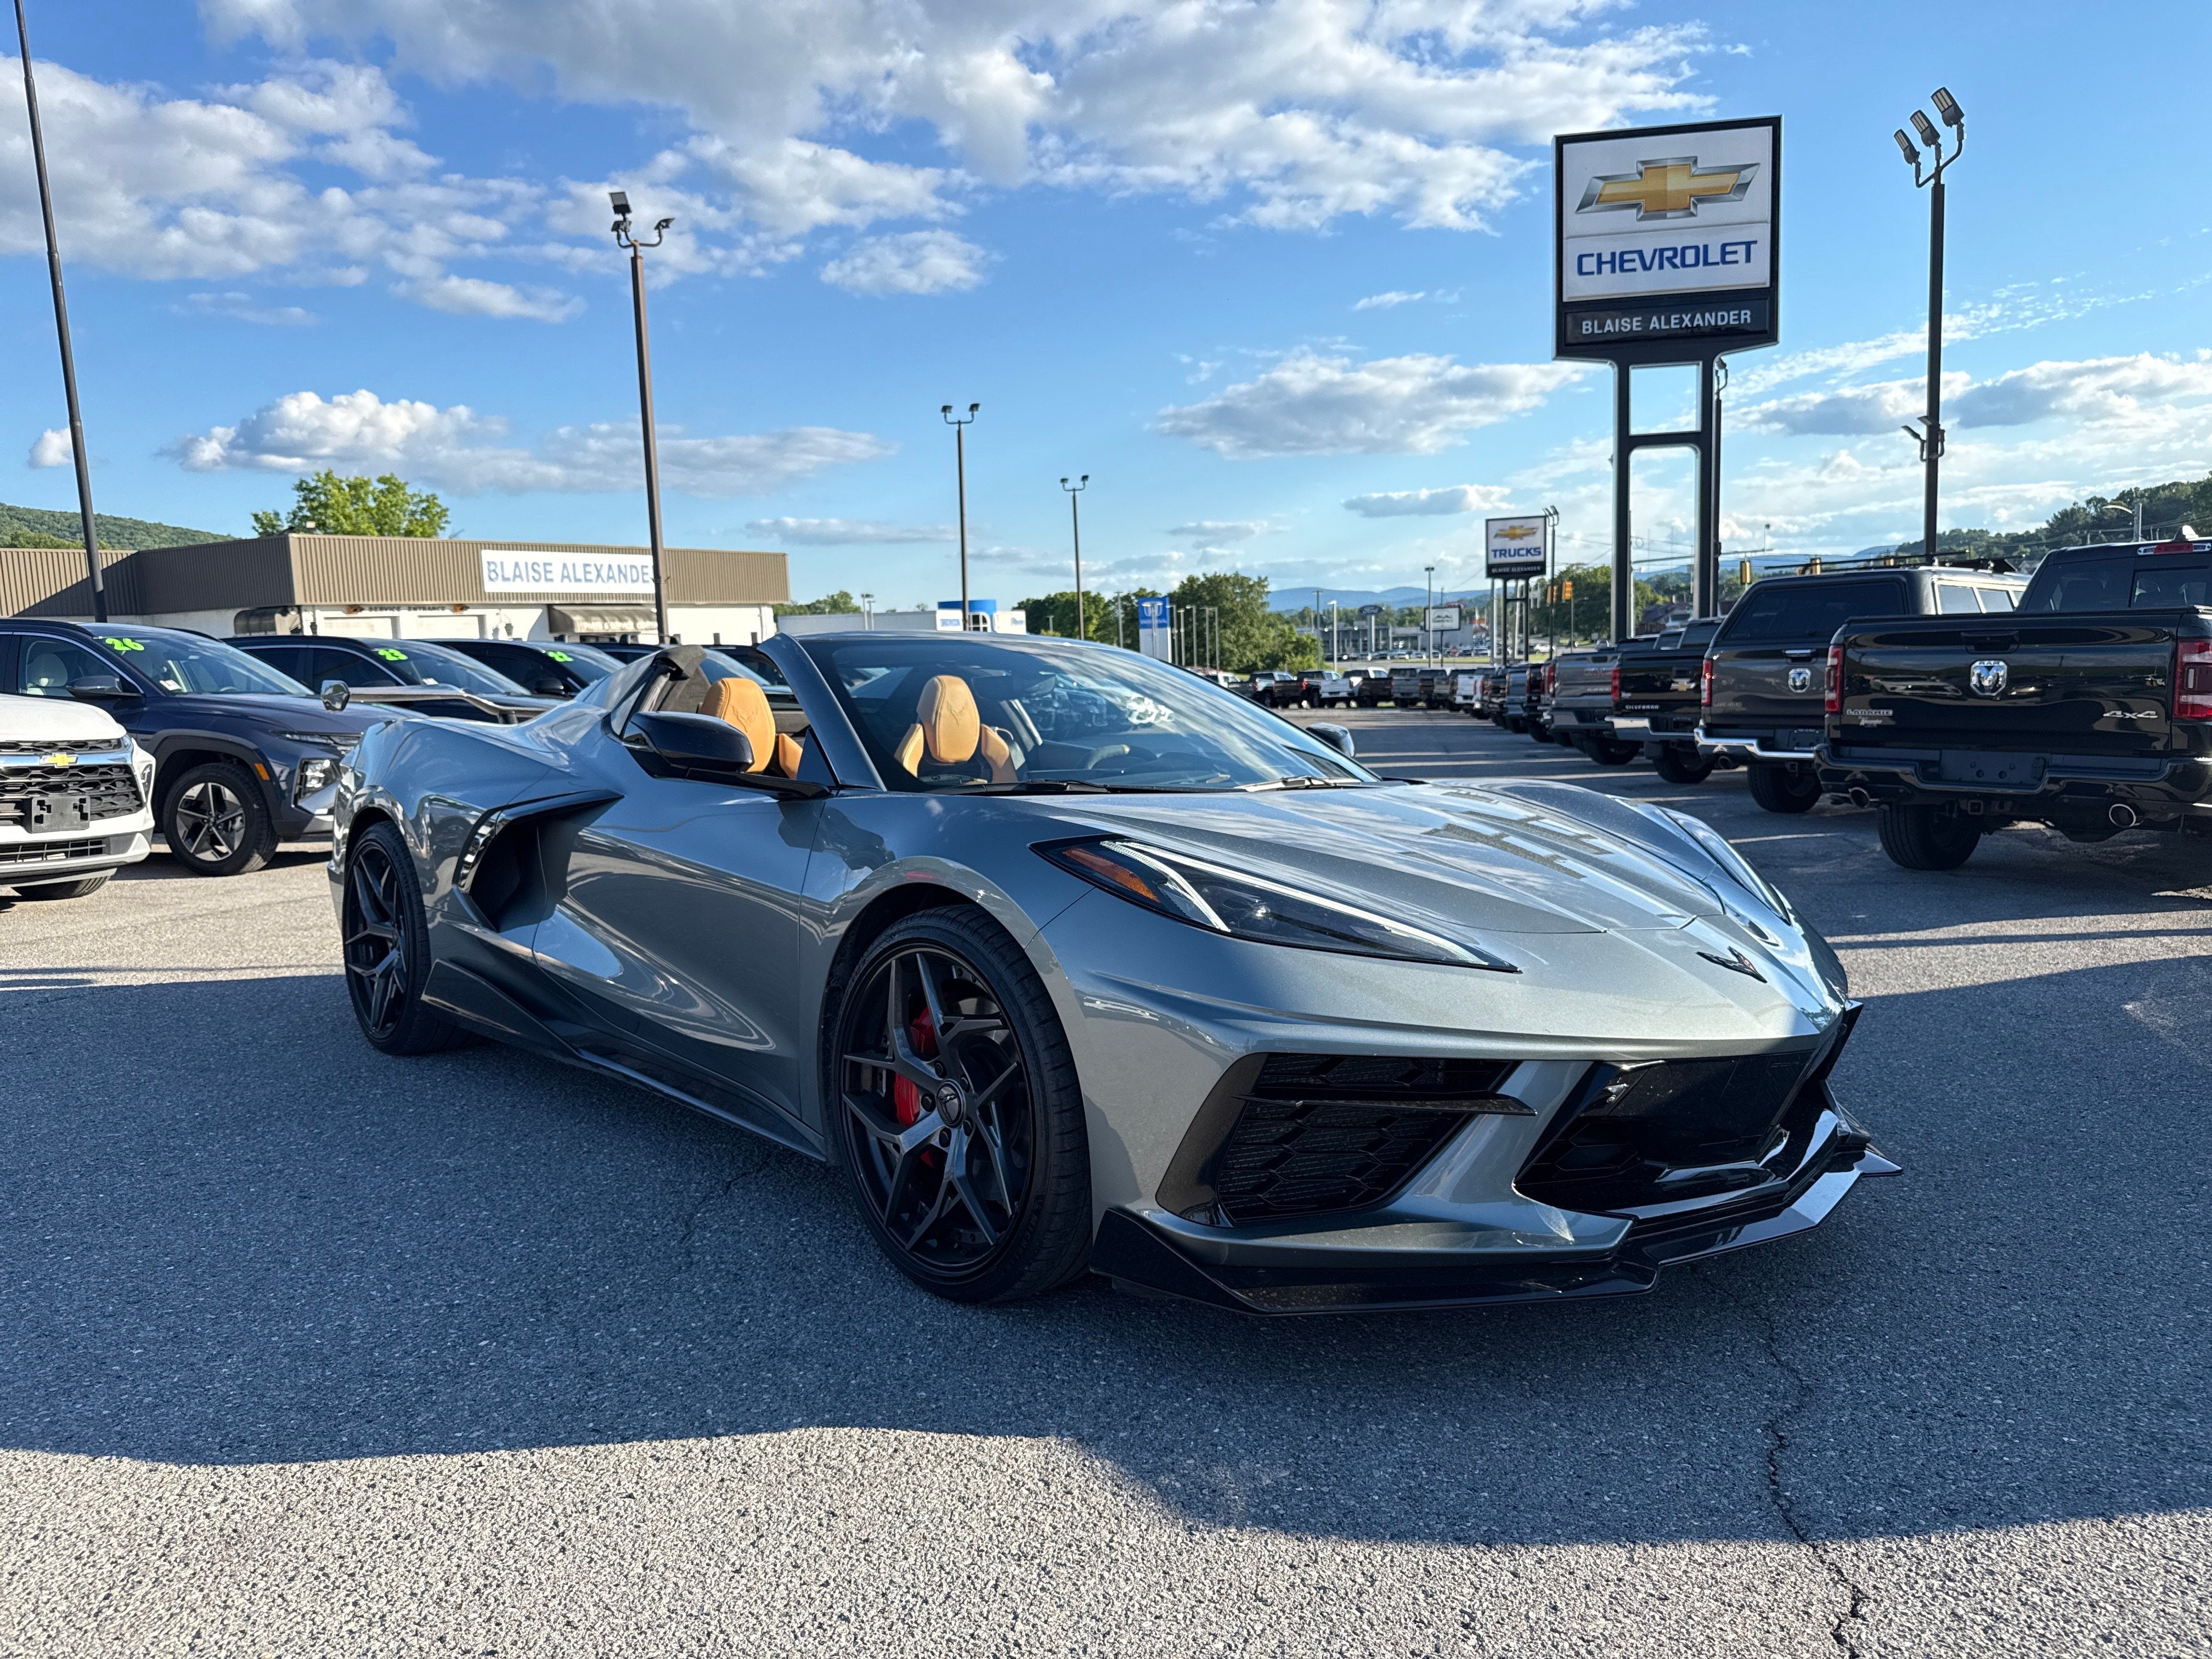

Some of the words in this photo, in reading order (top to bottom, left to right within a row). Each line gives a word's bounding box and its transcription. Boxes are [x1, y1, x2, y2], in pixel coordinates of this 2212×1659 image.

[1577, 240, 1758, 276] CHEVROLET
[1582, 317, 1642, 335] BLAISE
[1649, 309, 1751, 330] ALEXANDER
[1492, 547, 1541, 558] TRUCKS
[487, 561, 554, 583] BLAISE
[561, 562, 653, 584] ALEXANDE
[105, 637, 145, 651] 26
[1846, 708, 1893, 716] LARAMIE
